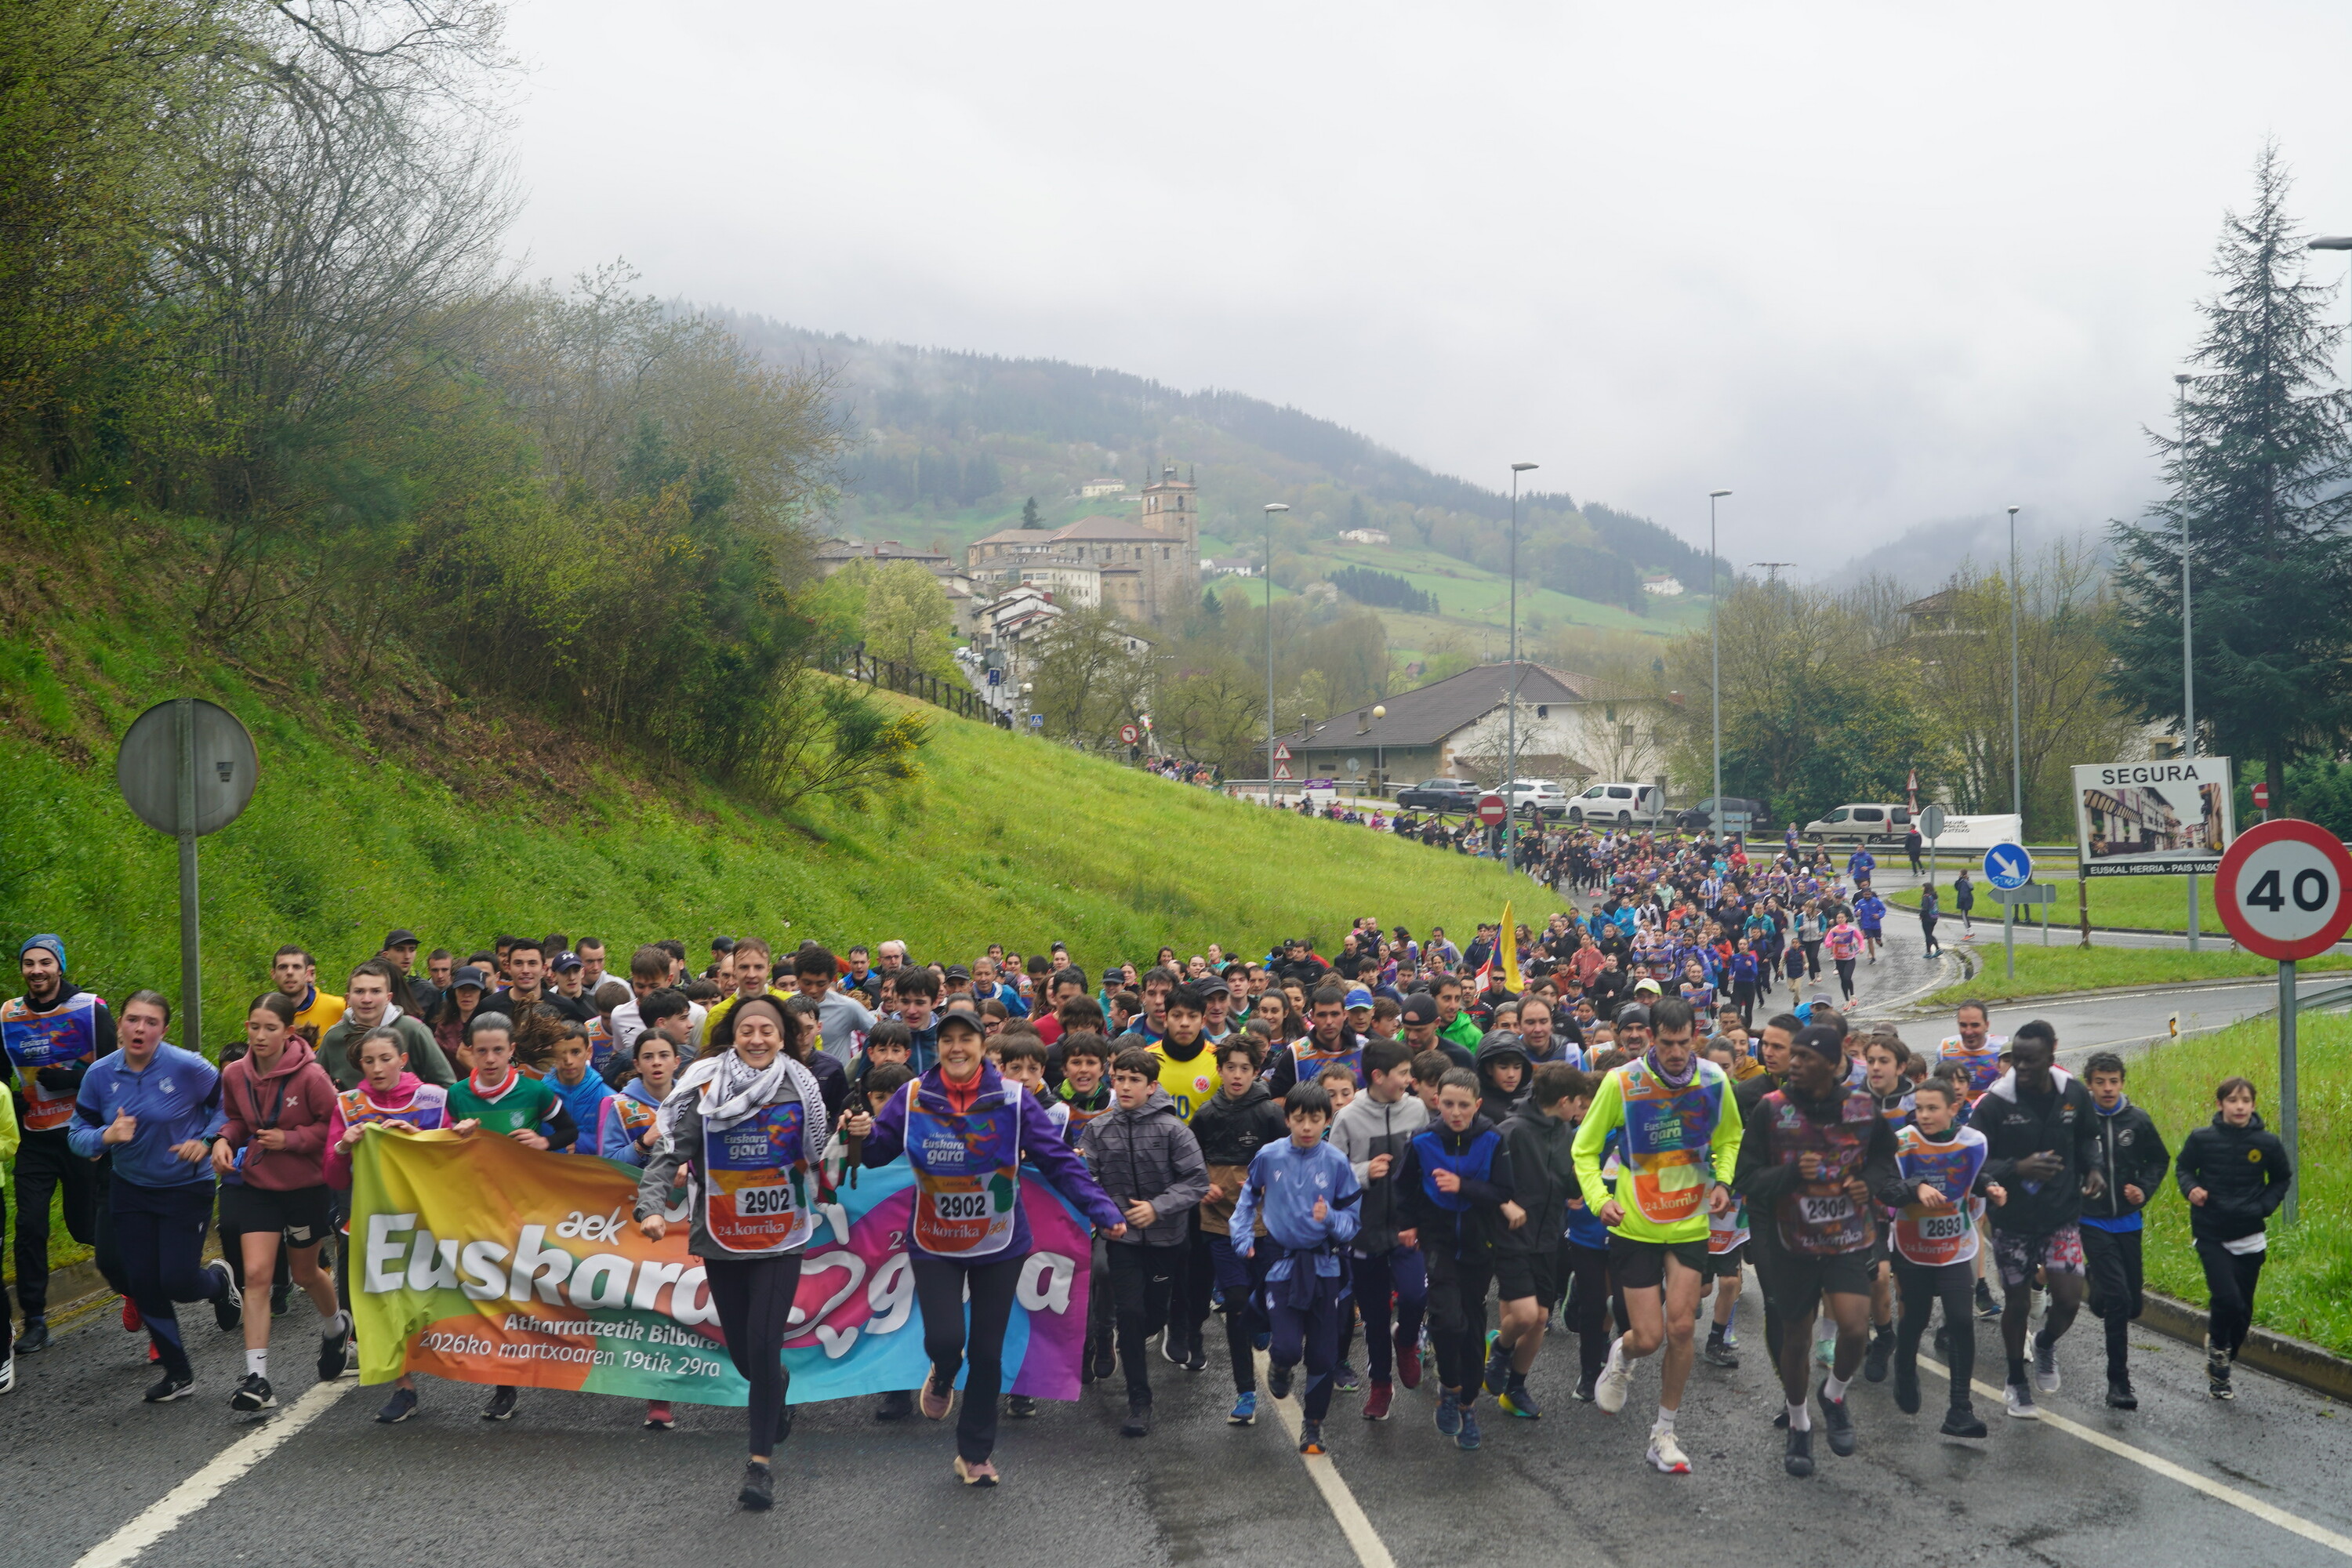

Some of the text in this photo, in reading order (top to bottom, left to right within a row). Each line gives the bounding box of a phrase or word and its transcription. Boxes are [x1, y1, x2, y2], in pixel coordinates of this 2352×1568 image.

[2102, 765, 2199, 785] SEGURA
[2090, 865, 2129, 874] EUSKAL
[2129, 864, 2165, 873] HERRIA
[2171, 863, 2193, 873] PAIS
[2195, 863, 2218, 872] VASC
[2246, 868, 2329, 912] 40
[1643, 1119, 1681, 1132] Euskara
[724, 1134, 768, 1144] Euskara
[922, 1138, 965, 1150] Euskara
[1649, 1127, 1682, 1145] gara
[729, 1144, 768, 1160] gara
[927, 1149, 965, 1166] gara
[745, 1188, 790, 1214] 2902
[941, 1195, 986, 1218] 2902
[1646, 1192, 1698, 1212] 24.korrika
[555, 1206, 627, 1247] aek
[717, 1220, 785, 1236] 24.korrika
[920, 1220, 980, 1238] 24.korrika
[989, 1218, 1008, 1236] aek
[1927, 1217, 1960, 1237] 2893
[2053, 1240, 2083, 1264] 23
[363, 1212, 1076, 1335] Euskara ga
[503, 1313, 721, 1351] Atharratzetik Bilbora
[419, 1330, 720, 1377] 2026ko martxoaren 19tik 29ra
